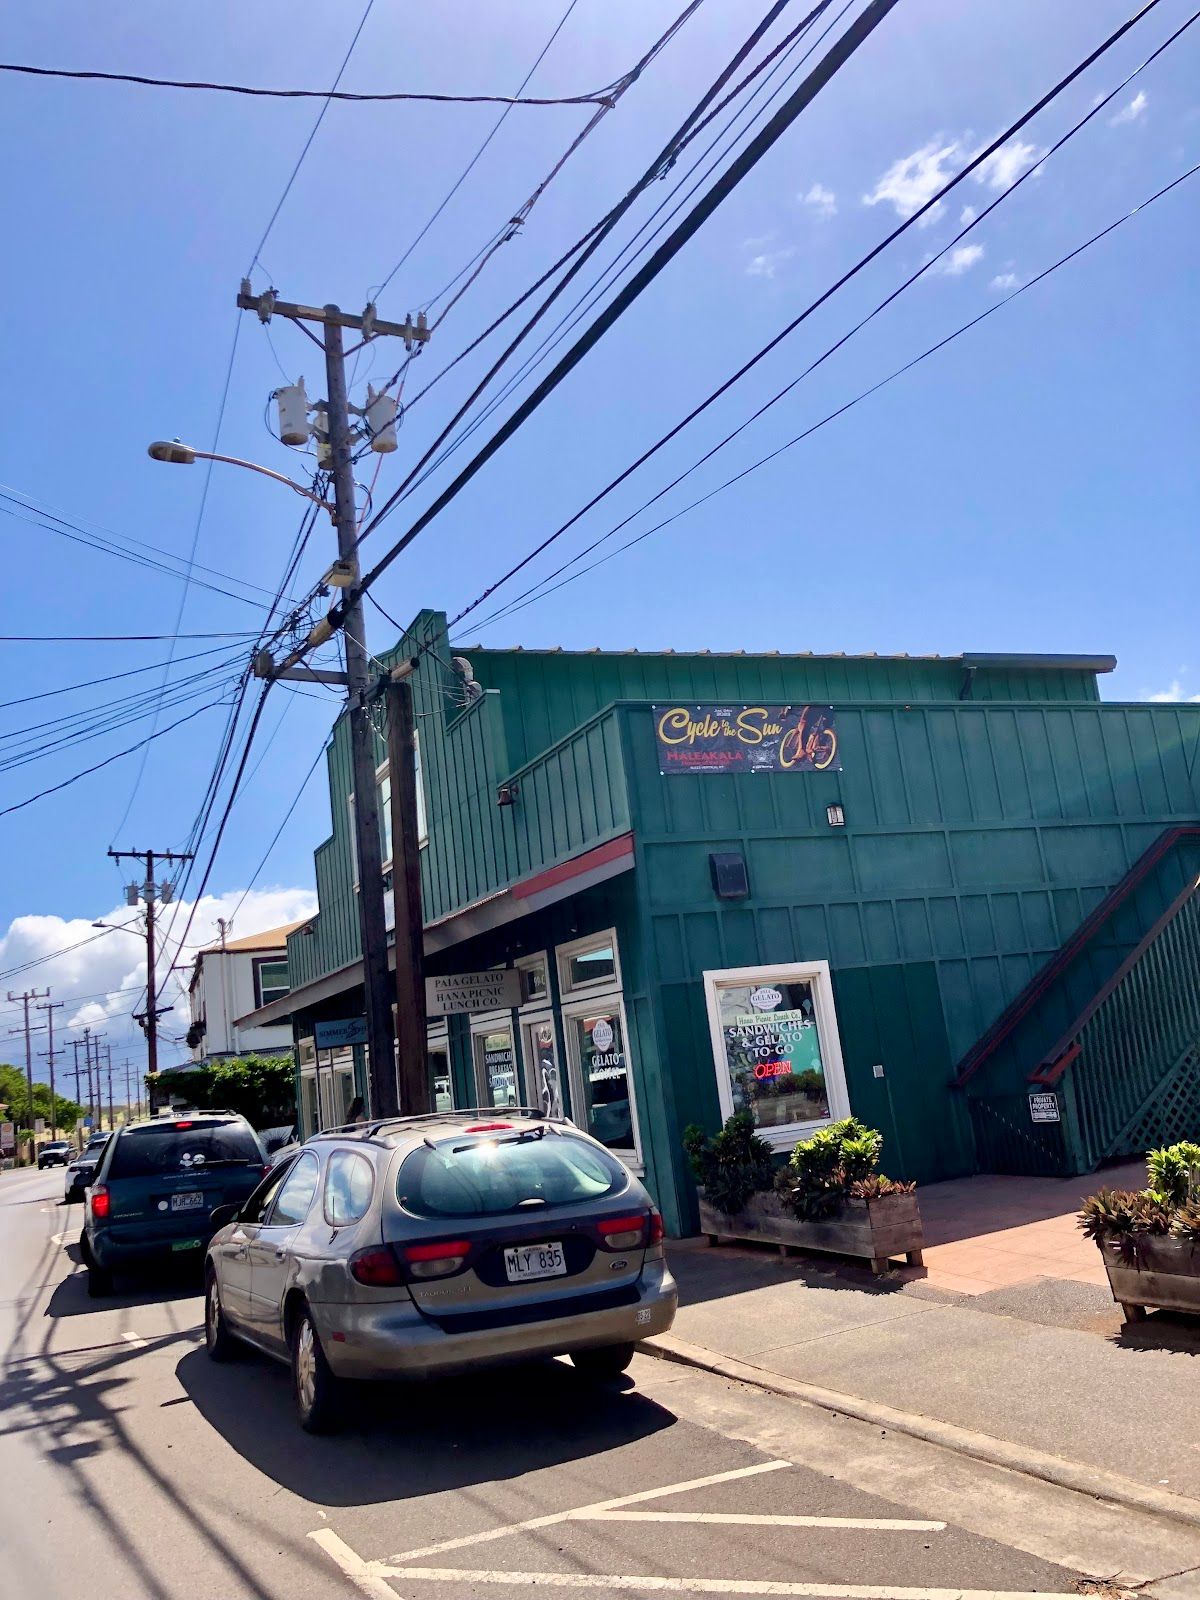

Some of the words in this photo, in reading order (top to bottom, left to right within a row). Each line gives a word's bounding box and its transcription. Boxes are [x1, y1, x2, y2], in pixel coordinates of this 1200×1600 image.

[659, 708, 721, 744] Cycle
[723, 726, 737, 737] the
[737, 708, 783, 744] Sun
[667, 751, 743, 761] HALEAKALA
[435, 978, 459, 988] PAIA
[461, 973, 503, 985] GELATO
[437, 991, 466, 1002] HANA
[469, 987, 504, 999] PICNIC
[753, 993, 780, 1002] GELATO
[443, 1000, 480, 1011] LUNCH
[483, 997, 501, 1007] CO.
[728, 1019, 812, 1038] SANDWICHES
[742, 1037, 751, 1048] &
[755, 1032, 803, 1047] GELATO
[752, 1044, 794, 1058] TO-GO
[591, 1053, 620, 1067] GELATO
[754, 1061, 792, 1079] OPEN
[507, 1253, 531, 1274] MLY
[539, 1249, 562, 1269] 835
